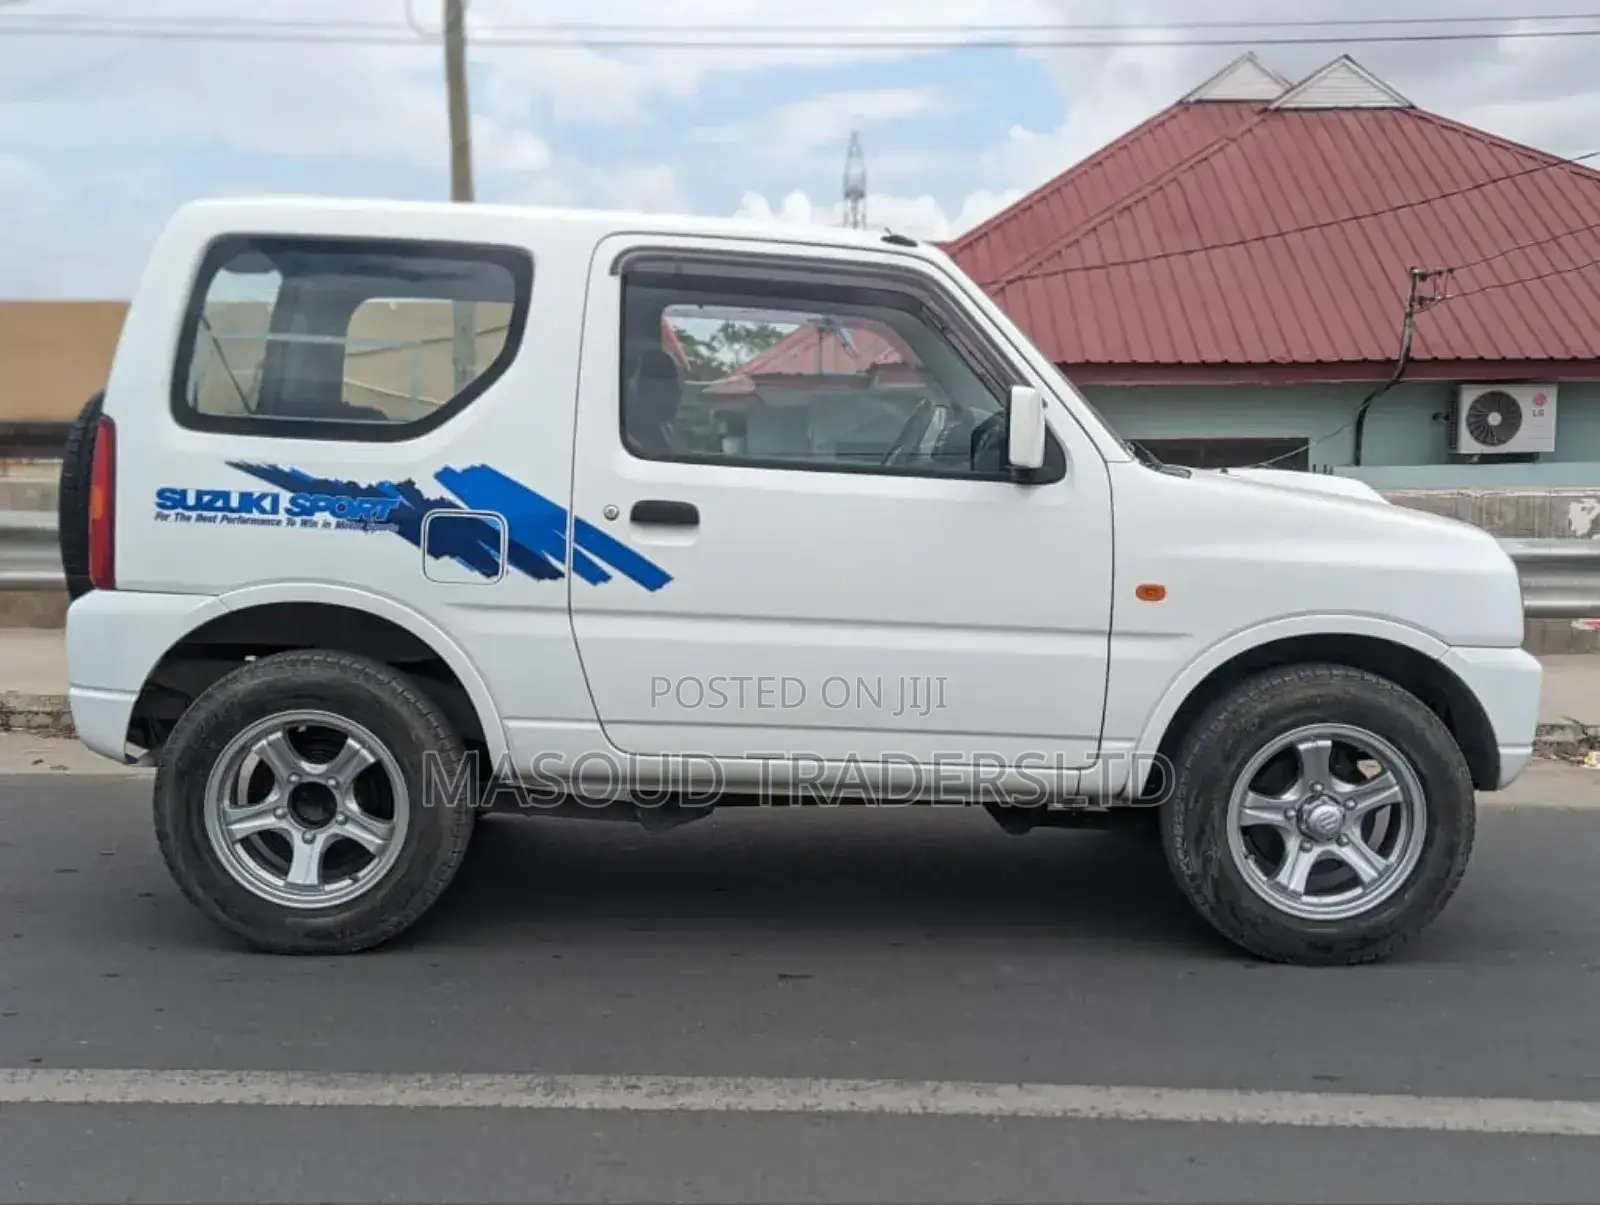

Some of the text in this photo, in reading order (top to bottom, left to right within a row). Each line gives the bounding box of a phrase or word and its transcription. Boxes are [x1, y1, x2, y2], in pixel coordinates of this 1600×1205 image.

[1532, 409, 1545, 417] LG
[155, 488, 400, 521] SUZUKI SPORT
[154, 511, 172, 523] For
[174, 512, 192, 523] The
[195, 513, 216, 524] Best
[220, 514, 282, 527] Performance
[285, 517, 297, 527] To
